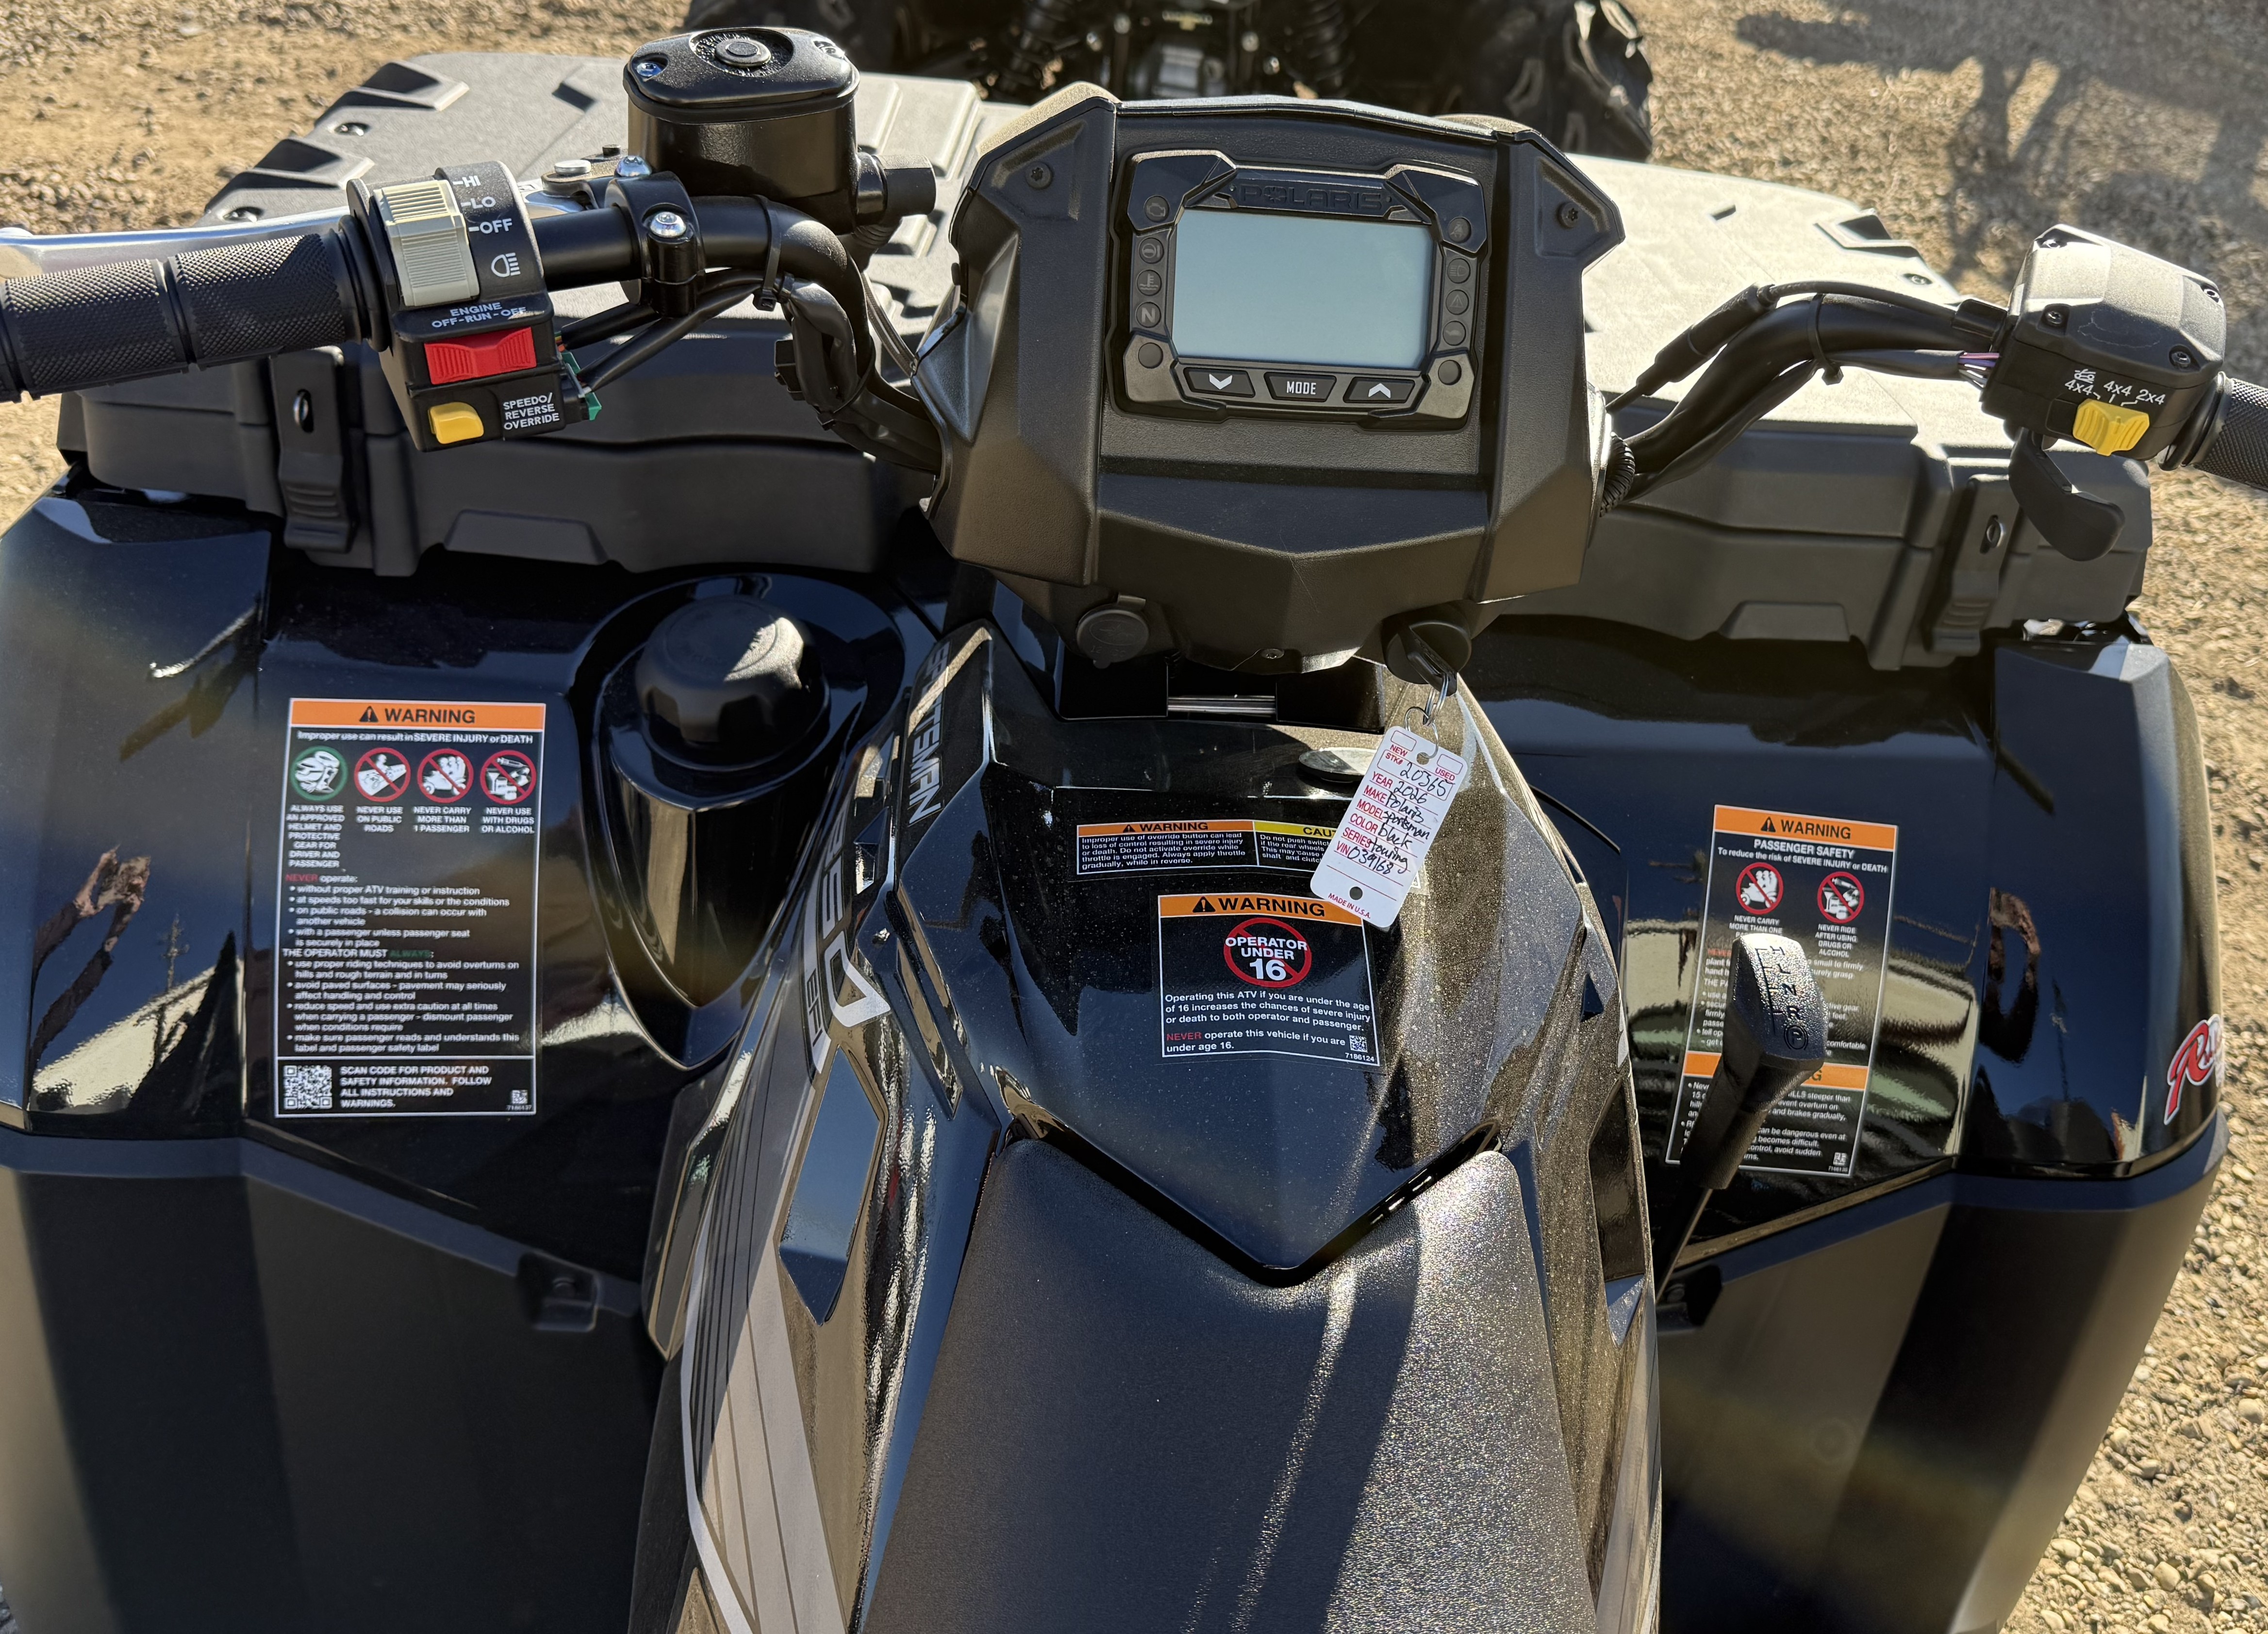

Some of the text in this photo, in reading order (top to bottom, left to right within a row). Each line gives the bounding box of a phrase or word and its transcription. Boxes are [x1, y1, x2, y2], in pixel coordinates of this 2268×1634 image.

[1241, 183, 1383, 211] POLARIS
[450, 302, 502, 317] ENGINE
[1286, 381, 1316, 396] MODE
[2065, 380, 2166, 405] 4x4 4x4 2x4
[503, 393, 552, 411] SPEEDO/
[505, 404, 555, 420] REVERSE
[504, 413, 560, 430] OVERRIDE
[384, 709, 475, 723] WARNING
[297, 731, 341, 741] Improper
[376, 733, 404, 742] result
[403, 733, 414, 741] in
[413, 733, 452, 742] SEVERE
[452, 734, 489, 743] INJURY
[499, 734, 533, 743] DEATH
[1390, 744, 1407, 757] NEW
[1385, 753, 1403, 765] STK#
[1371, 771, 1393, 789] YEAR
[1400, 761, 1455, 797] 20365
[1435, 767, 1456, 781] USED
[1364, 785, 1388, 803] MAKE
[1394, 781, 1428, 804] 2026
[1357, 799, 1384, 820] MODEL
[371, 815, 402, 824] PUBLIC
[505, 816, 534, 825] DRUGS
[1350, 813, 1378, 834] COLOR
[419, 825, 470, 833] PASSENGER
[495, 825, 535, 834] ALCOHOL
[1139, 822, 1208, 832] WARNING
[1781, 820, 1851, 839] WARNING
[1342, 827, 1372, 849] SERIES
[1336, 841, 1350, 856] VIN
[1754, 840, 1854, 858] PASSENGER SAFETY
[1348, 846, 1393, 875] 039168
[1718, 847, 1728, 856] To
[1728, 849, 1755, 858] reduce
[1755, 851, 1768, 860] the
[1768, 853, 1782, 861] risk
[1792, 856, 1822, 866] SEVERE
[1823, 859, 1852, 868] INJURY
[1861, 863, 1888, 873] DEATH
[286, 874, 318, 882] NEVER
[1218, 897, 1325, 916] WARNING
[1328, 892, 1371, 919] MADE IN U.S.A.
[1757, 917, 1780, 925] CARRY
[1729, 923, 1748, 931] MORE
[1750, 924, 1768, 934] THAN
[1840, 926, 1856, 934] RIDE
[1225, 937, 1308, 950] OPERATOR
[1815, 932, 1857, 942] AFTER USING
[1818, 940, 1841, 949] DRUGS
[1241, 948, 1294, 960] UNDER
[1819, 949, 1850, 957] ALCOHOL
[1249, 959, 1286, 980] 16
[1165, 993, 1214, 1003] Operating
[1237, 990, 1258, 999] ATV
[1306, 997, 1333, 1005] under
[1335, 999, 1351, 1008] the
[1353, 1003, 1370, 1011] age
[1165, 1005, 1175, 1013] of
[1259, 1002, 1299, 1011] chances
[1312, 1008, 1343, 1017] severe
[1345, 1011, 1371, 1023] injury
[1178, 1014, 1207, 1023] death
[1223, 1012, 1245, 1021] both
[1312, 1019, 1364, 1031] passenger.
[1166, 1032, 1202, 1041] NEVER
[1204, 1031, 1243, 1040] operate
[1245, 1029, 1264, 1037] this
[1266, 1030, 1301, 1040] vehicle
[1303, 1033, 1309, 1041] if
[1166, 1041, 1234, 1053] under age 16.
[1345, 1052, 1374, 1061] 7186124
[340, 1066, 489, 1075] SCAN CODE FOR PRODUCT AND
[340, 1076, 492, 1086] SAFETY INFORMATION. FOLLOW
[340, 1088, 454, 1097] ALL INSTRUCTIONS AND
[340, 1099, 396, 1107] WARNINGS.
